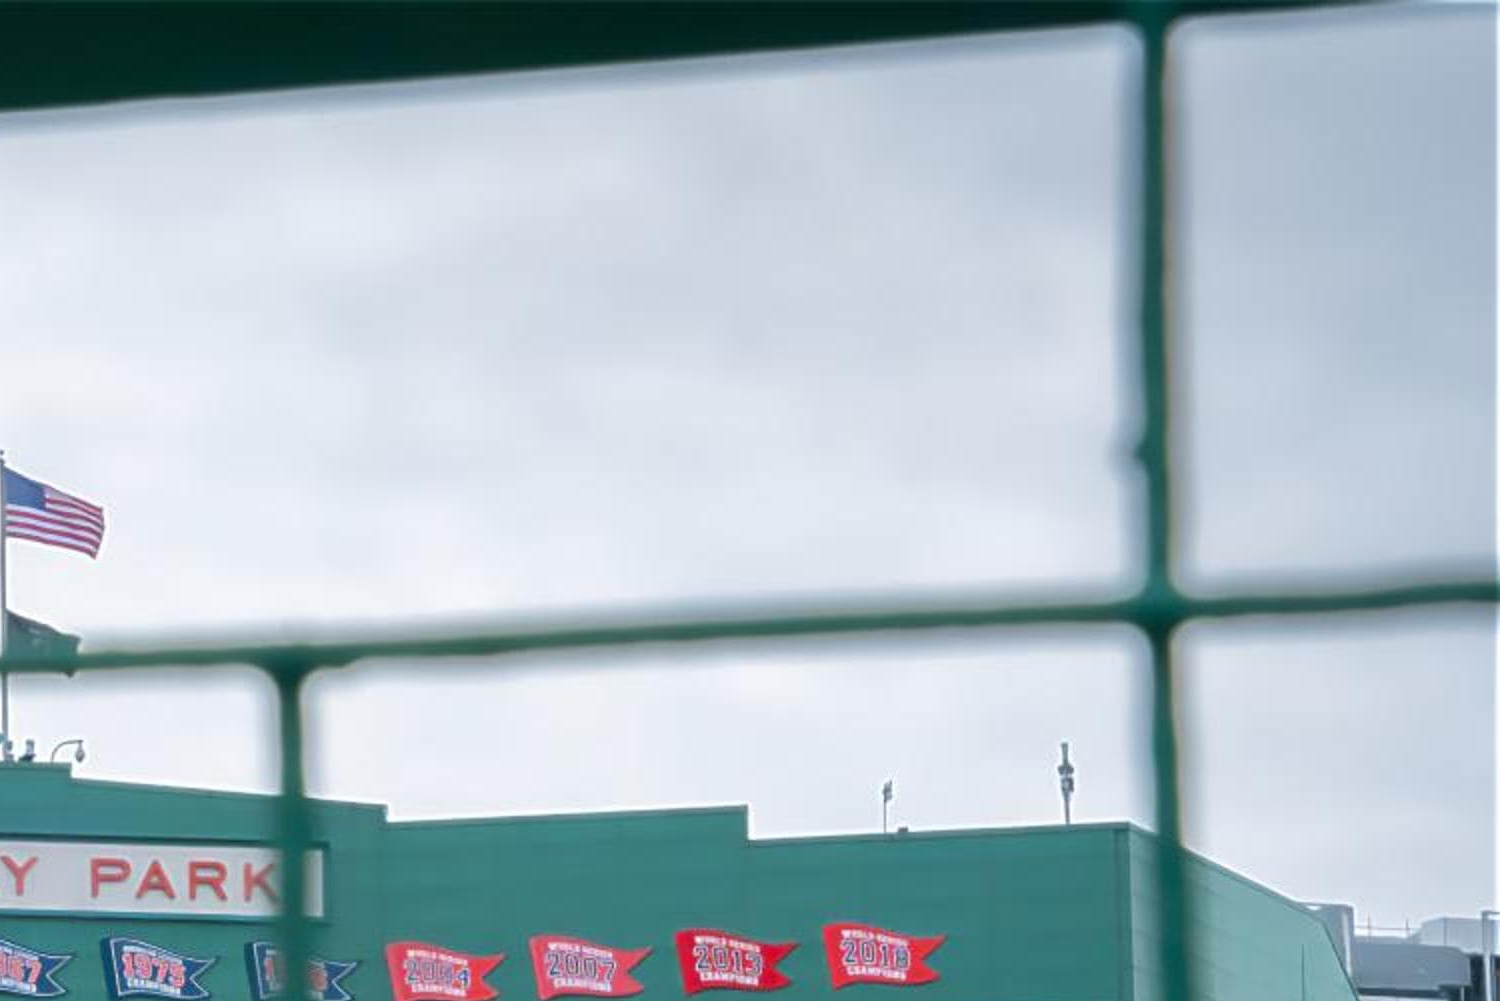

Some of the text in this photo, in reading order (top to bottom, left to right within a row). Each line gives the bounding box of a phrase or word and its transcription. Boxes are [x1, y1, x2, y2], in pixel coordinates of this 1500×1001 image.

[89, 857, 281, 902] PARK
[547, 952, 615, 982] 2007
[694, 944, 762, 976] 2013
[841, 938, 910, 969] 2018
